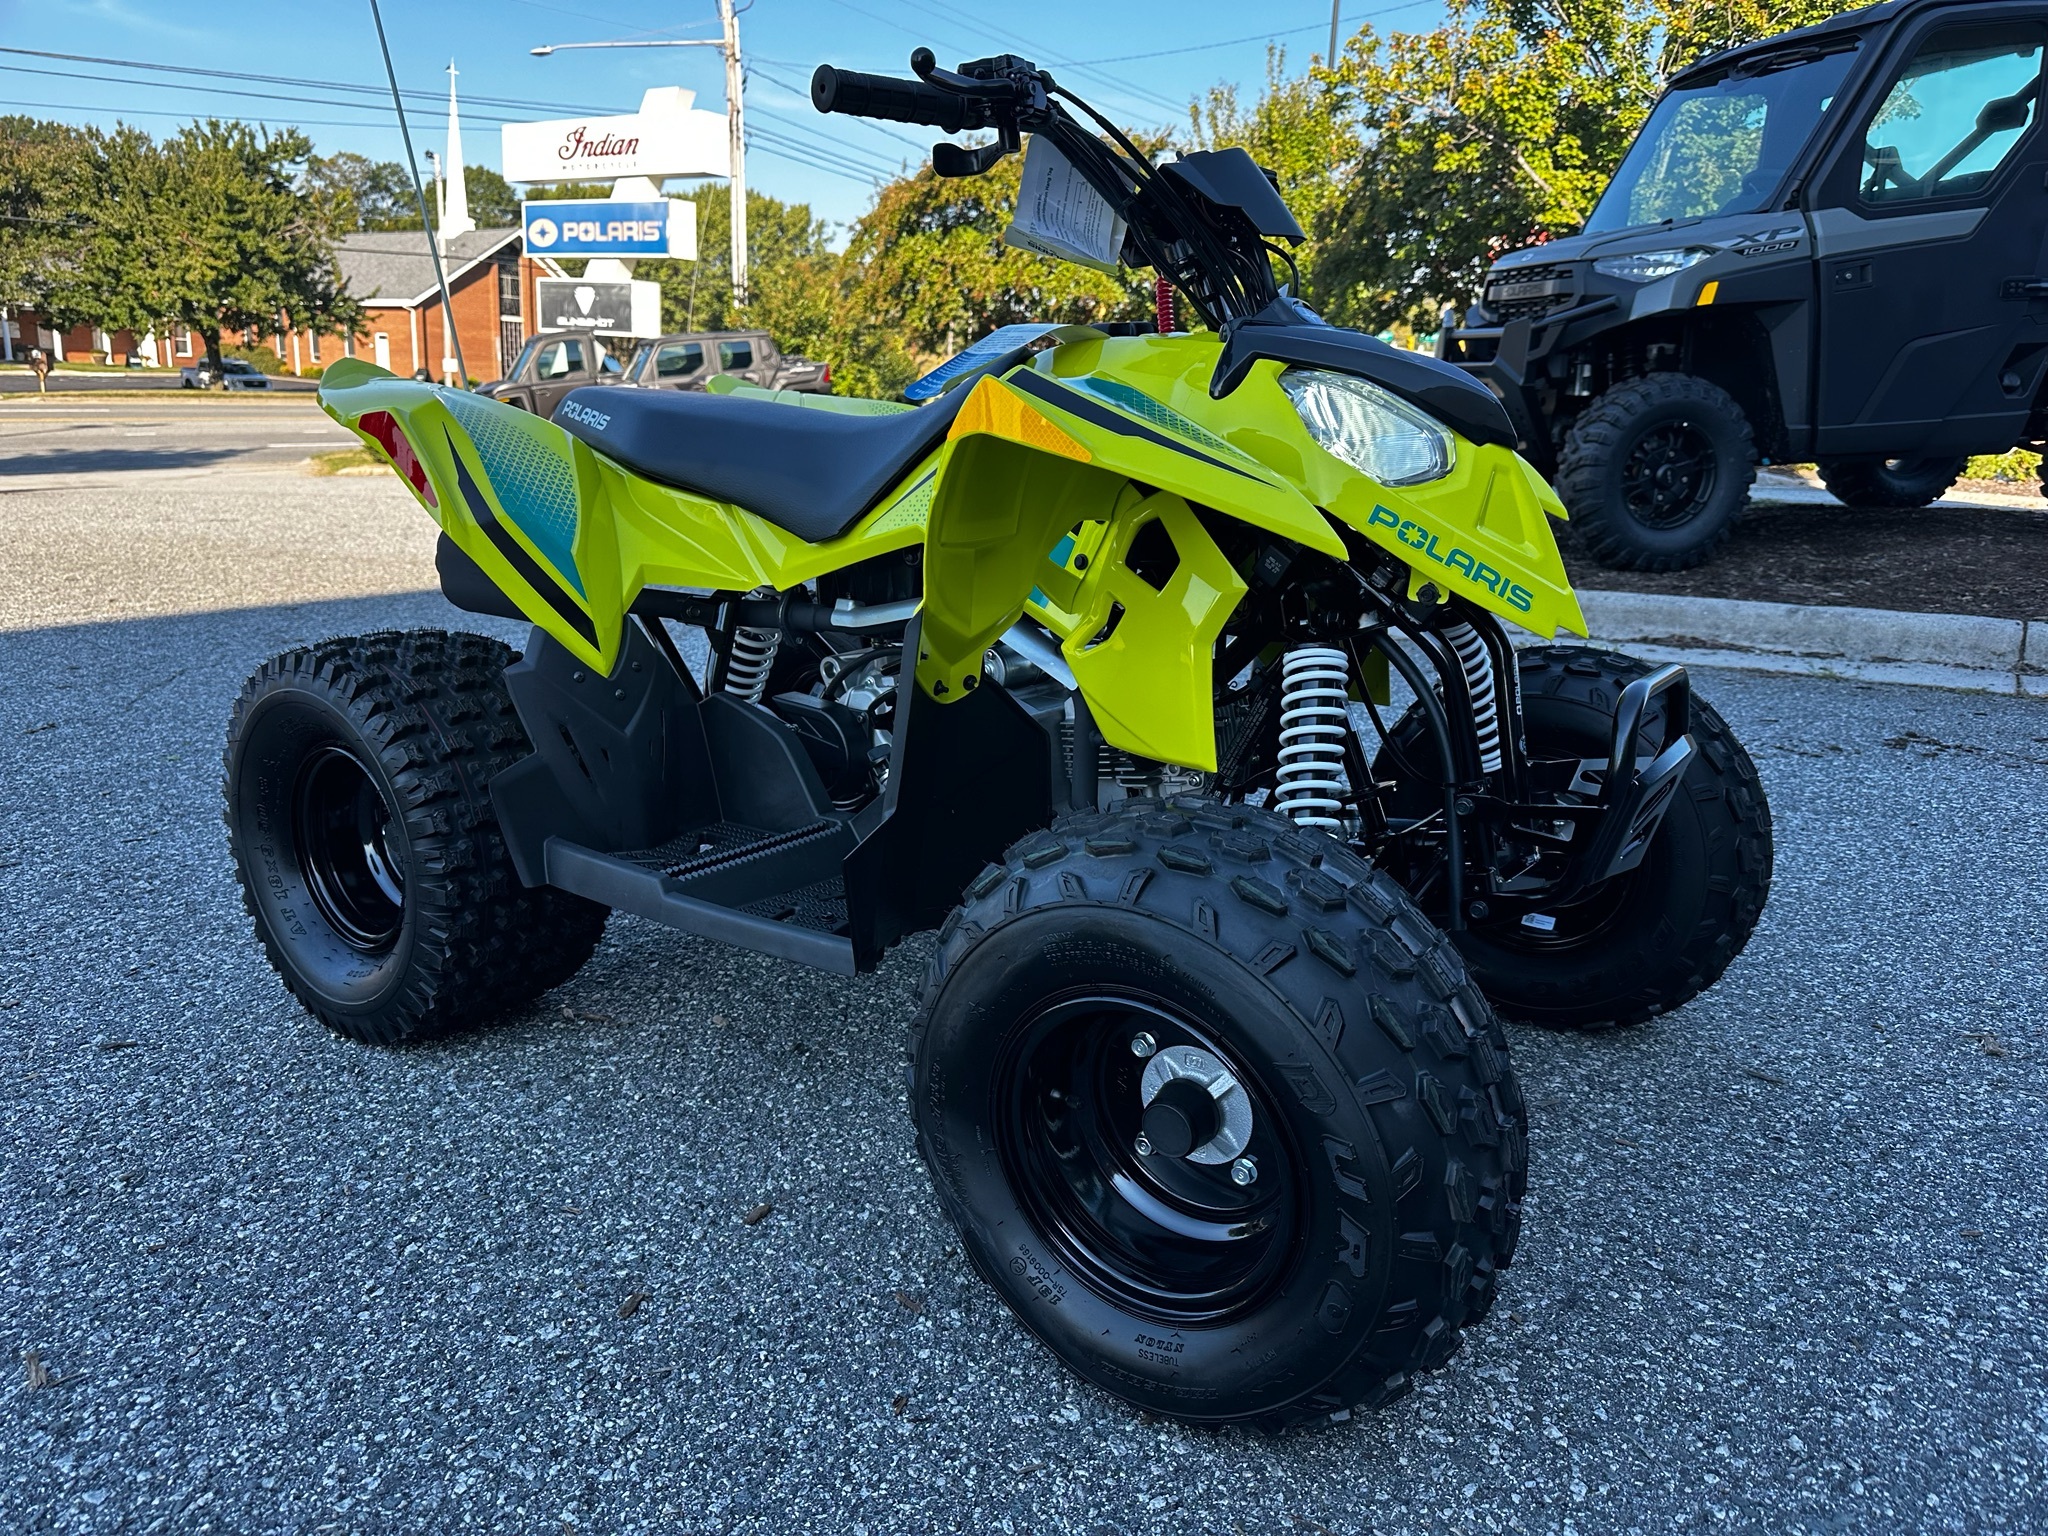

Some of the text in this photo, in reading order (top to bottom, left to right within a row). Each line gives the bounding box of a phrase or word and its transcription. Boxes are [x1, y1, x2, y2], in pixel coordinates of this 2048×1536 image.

[558, 126, 639, 160] Indian
[562, 220, 660, 243] POLARIS
[1730, 225, 1801, 247] XP
[1743, 241, 1796, 256] 1000
[561, 400, 611, 430] POLARIS
[1367, 503, 1535, 613] POLARIS
[1133, 1333, 1185, 1354] NYLON
[1137, 1348, 1179, 1367] TUBELESS
